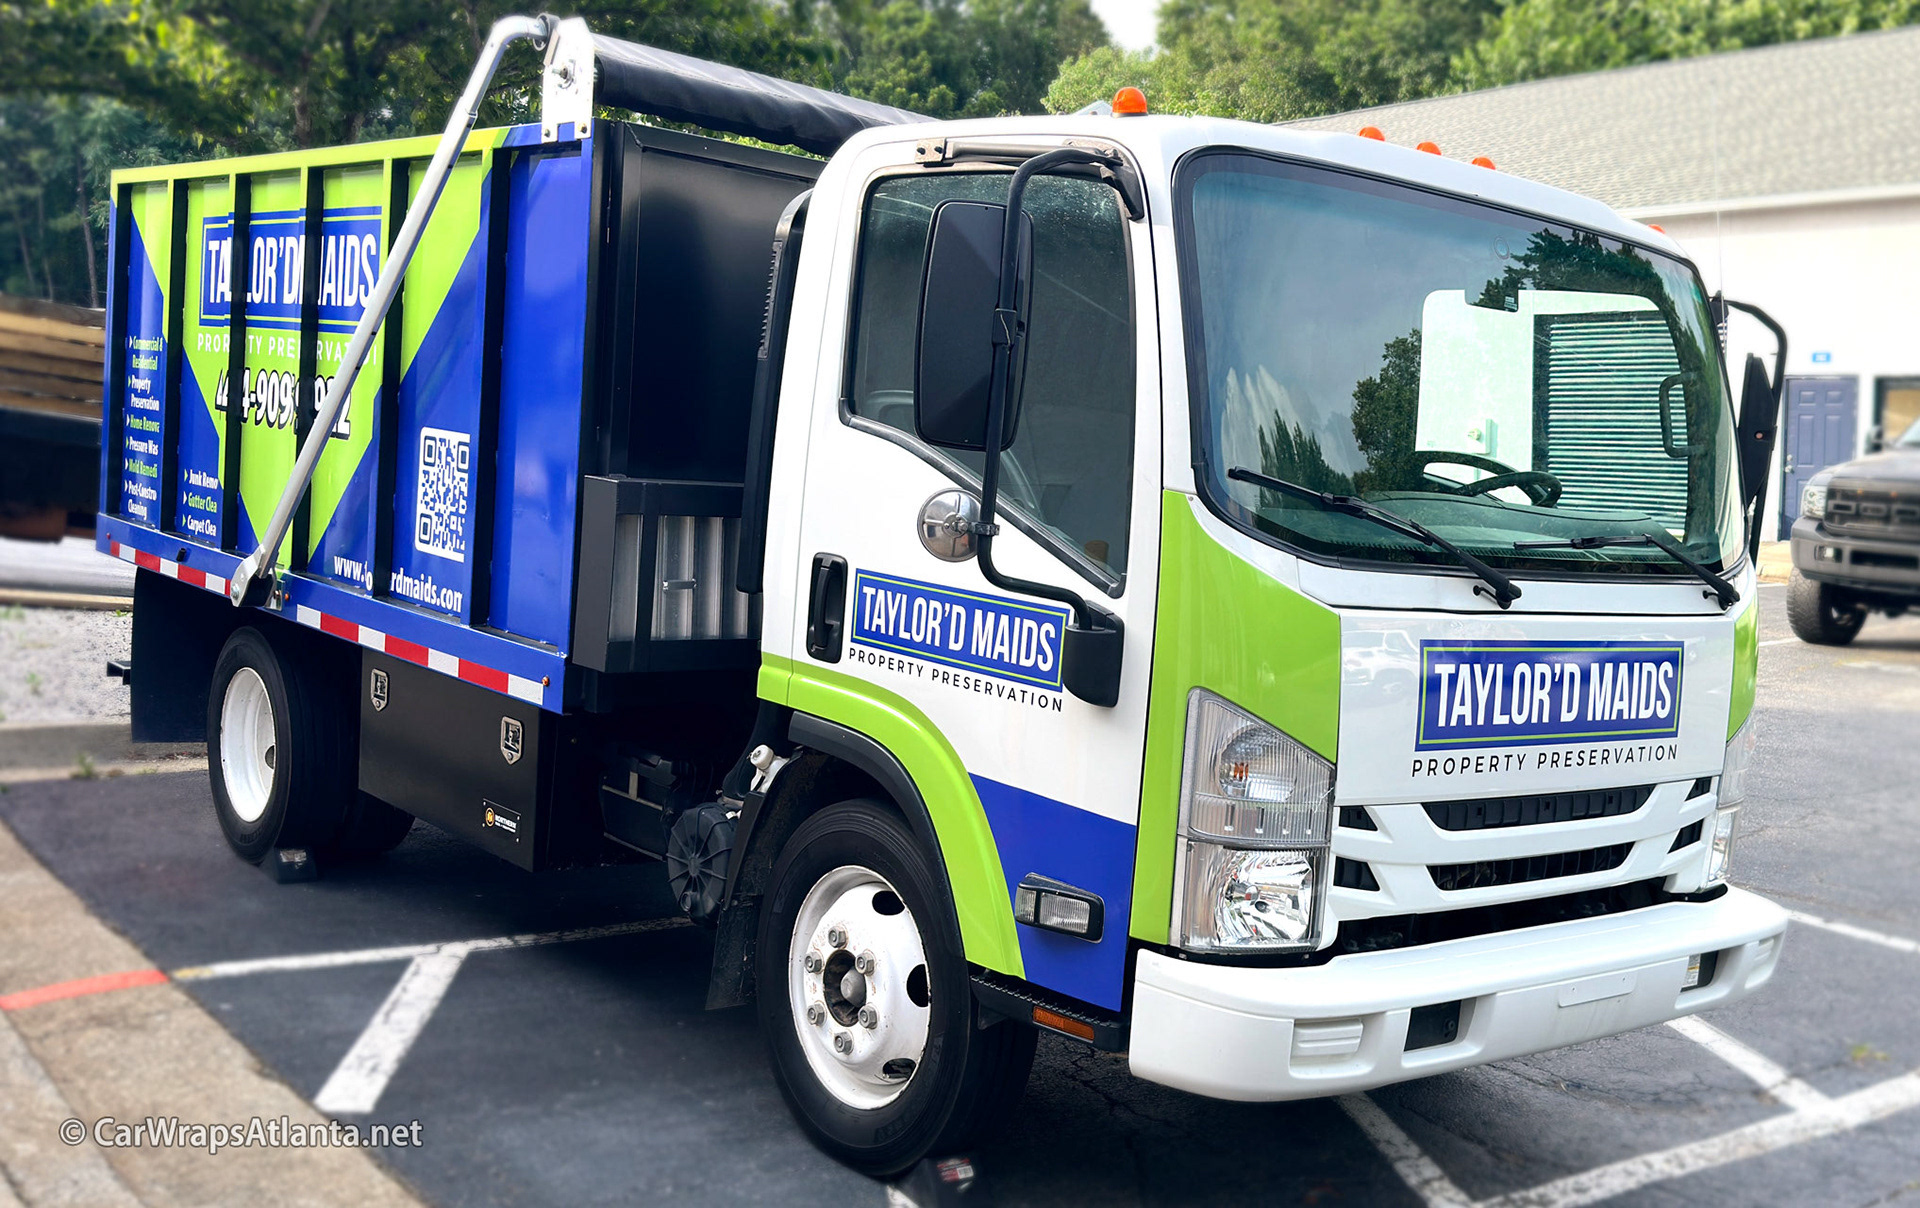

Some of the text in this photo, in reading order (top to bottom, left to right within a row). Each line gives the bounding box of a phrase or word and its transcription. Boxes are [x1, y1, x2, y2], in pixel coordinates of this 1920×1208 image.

[131, 374, 151, 394] Property
[130, 393, 160, 411] Preservation
[129, 435, 148, 454] Pressure
[188, 468, 202, 487] Junk
[127, 498, 147, 521] Cleaning
[187, 492, 205, 511] Gutter
[187, 514, 205, 535] Carpet
[863, 585, 1057, 672] TAYLOR'D MAIDS
[849, 647, 1063, 713] PROPERTY PRESERVATION
[1434, 661, 1674, 727] TAYLOR'D MAIDS
[1411, 744, 1678, 777] PROPERTY PRESERVATION
